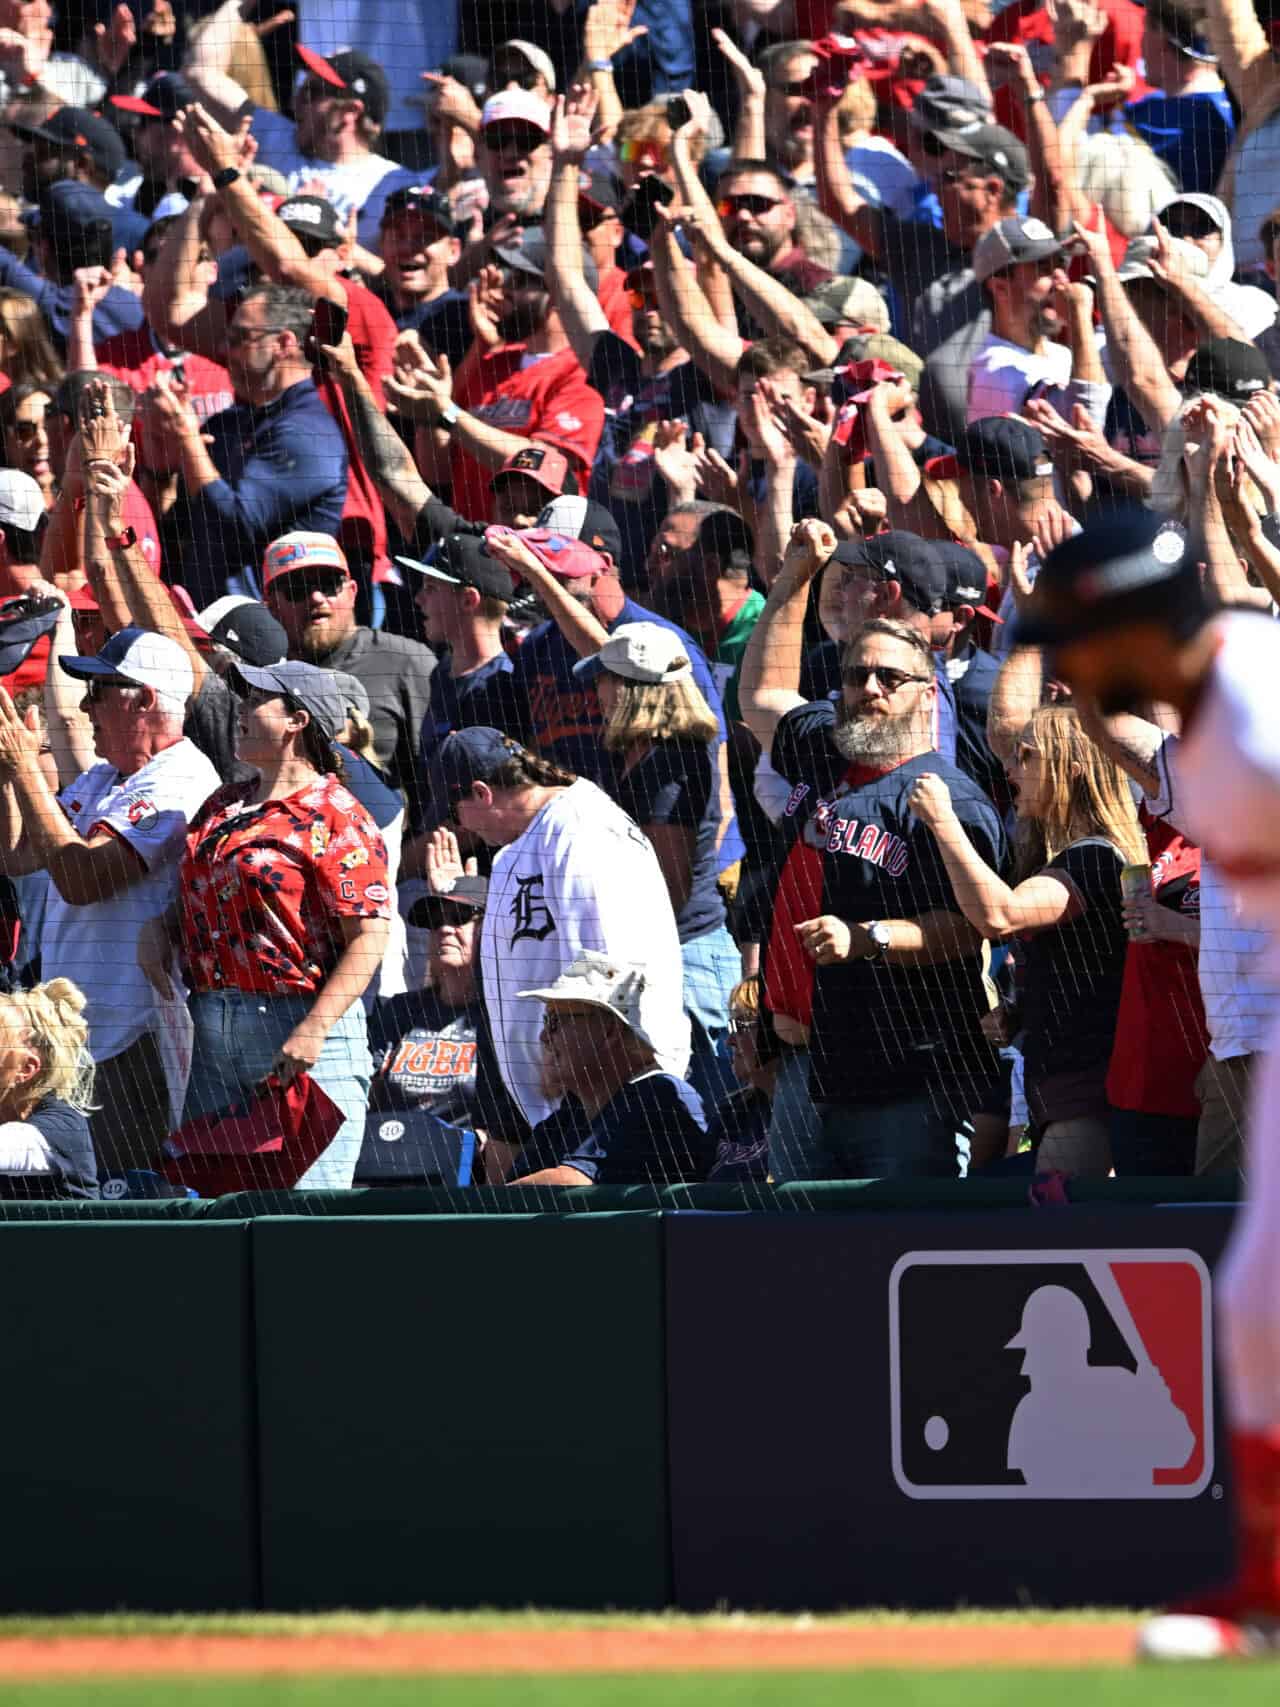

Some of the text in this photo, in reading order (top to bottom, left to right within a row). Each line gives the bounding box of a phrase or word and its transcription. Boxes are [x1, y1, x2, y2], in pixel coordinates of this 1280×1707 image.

[827, 817, 909, 877] ELAND
[341, 880, 356, 899] C
[382, 1040, 477, 1076] IGER
